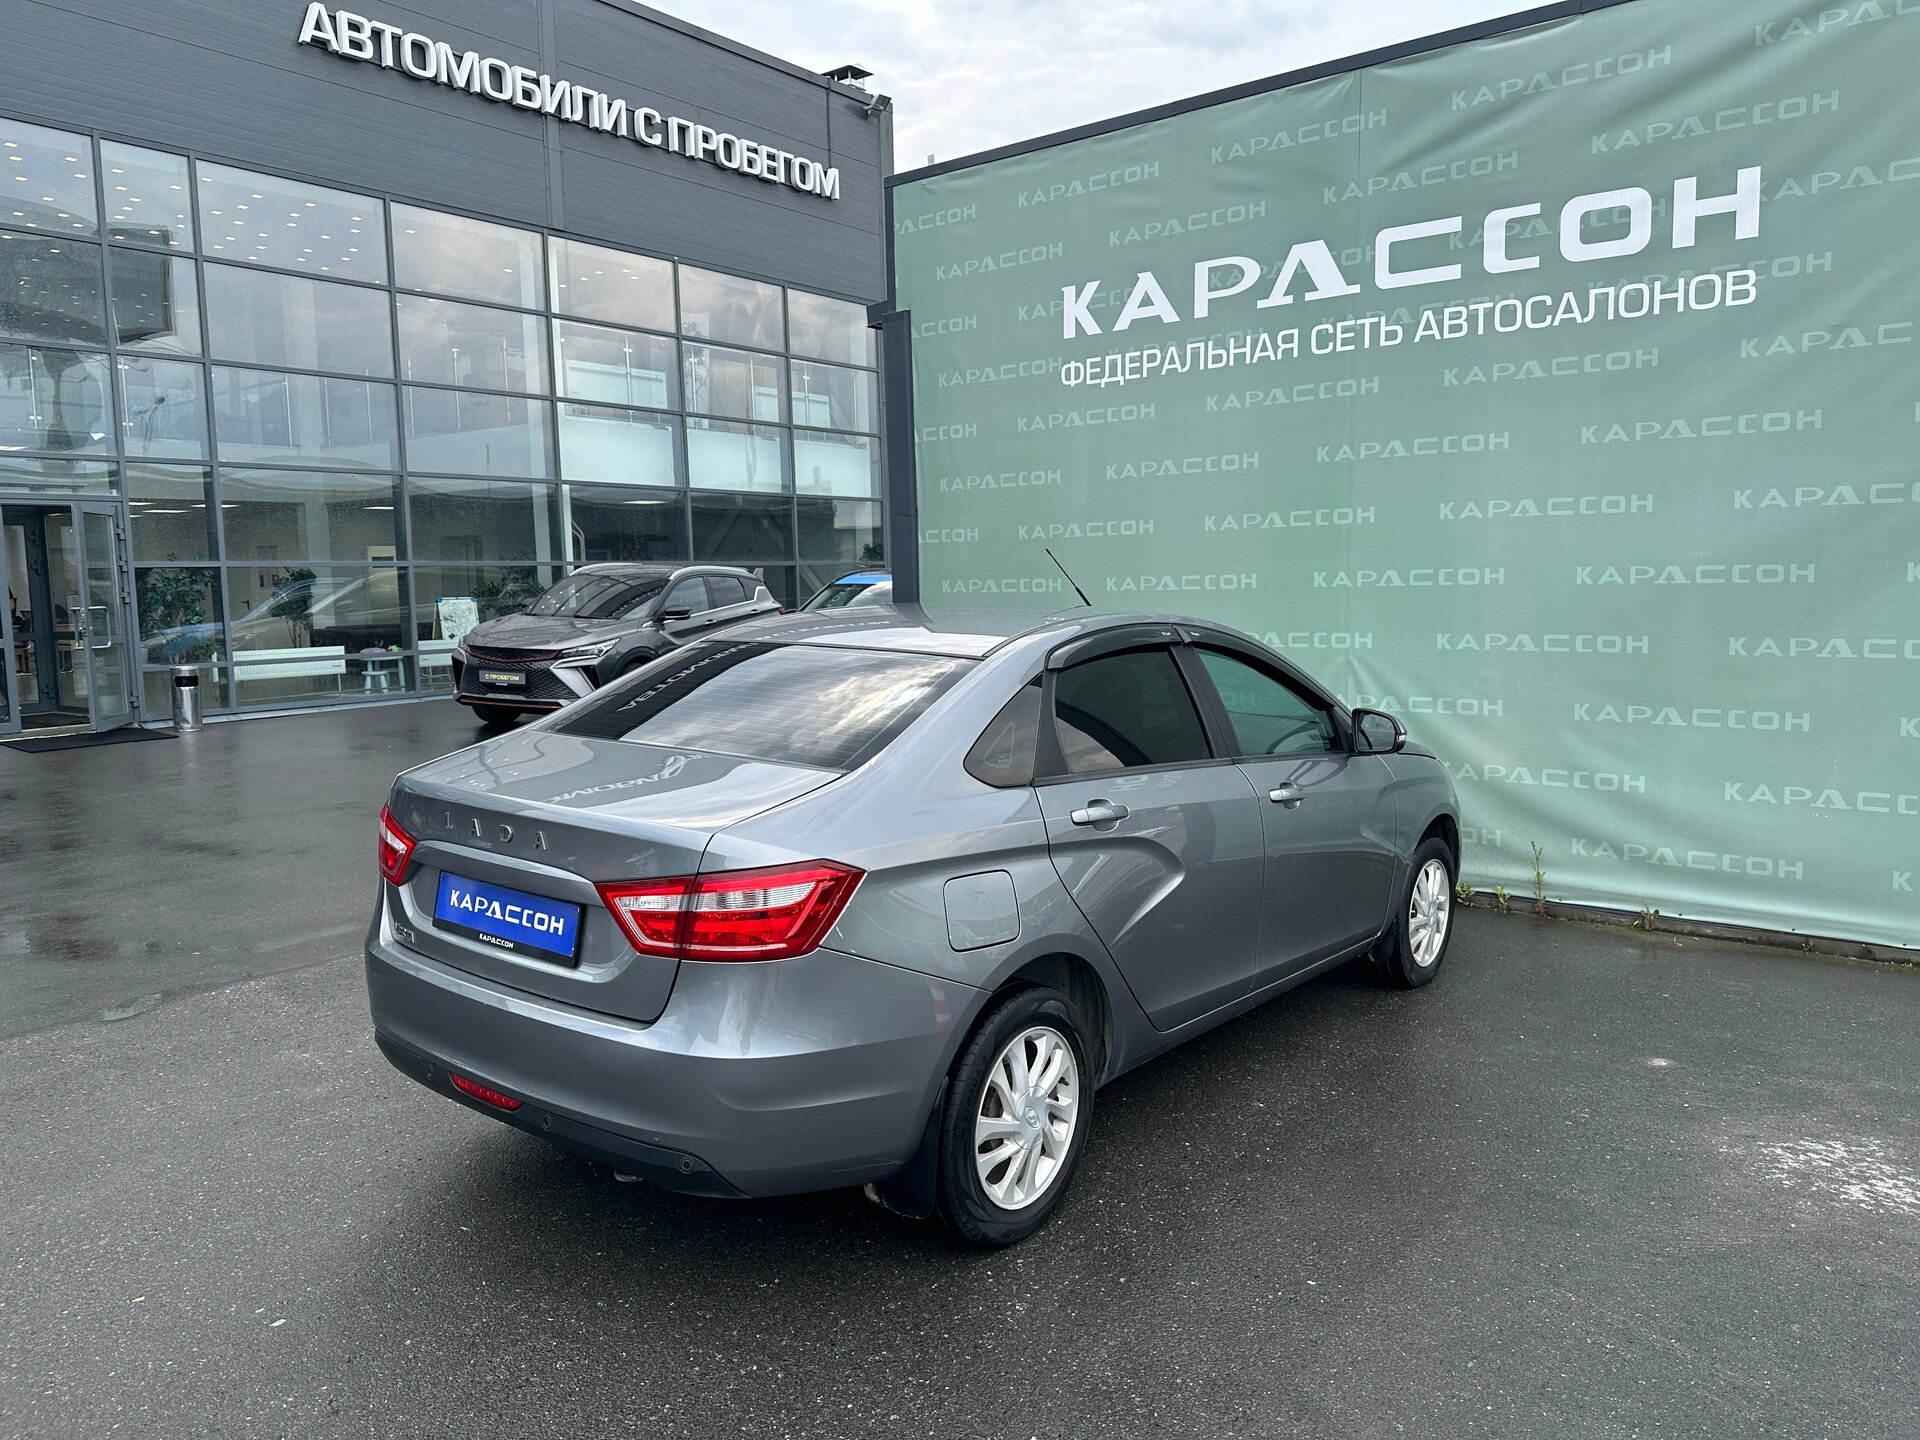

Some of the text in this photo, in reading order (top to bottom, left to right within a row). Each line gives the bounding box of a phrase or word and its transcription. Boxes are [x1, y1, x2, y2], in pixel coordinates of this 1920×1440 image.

[1451, 45, 1672, 111] КАРАССОН
[298, 1, 840, 200] АВТОМОБИЛИ С ПРОБЕГОМ
[1211, 108, 1388, 165] КАРАССОН
[1591, 89, 1840, 155] КАРАССОН
[1018, 160, 1160, 209] КАРАССОН
[1323, 150, 1519, 205] КАРАССОН
[1109, 201, 1266, 248] КАРАССОН
[936, 242, 1063, 281] КАРАССОН
[1061, 166, 1761, 340] КАРАССОН
[1060, 269, 1758, 388] ФЕДЕРАЛЬНАЯ СЕТЬ АВТОСАЛОНОВ
[1740, 322, 1913, 359] КАРАС
[939, 357, 1063, 388] КАРАССОН
[1444, 348, 1660, 387] КАРАССОН
[1206, 377, 1380, 412] КАРАССОН
[1017, 402, 1156, 433] КАРАССОН
[1580, 409, 1823, 445] КАРАССОН
[1316, 431, 1510, 464] КАРАССОН
[940, 469, 1062, 493] КАРАССОН
[1106, 452, 1260, 480] КАРАССОН
[1204, 506, 1376, 533] КАРАССОН
[1438, 494, 1654, 520] КАРАССОН
[1018, 519, 1155, 541] КАРАССОН
[942, 578, 1063, 594] КАРАССОН
[1106, 573, 1258, 592] КАРАССОН
[1313, 567, 1506, 588] КАРАССОН
[1576, 563, 1816, 585] КАРАССОН
[1436, 632, 1650, 655] КАРАССОН
[1573, 702, 1811, 732] КАРАССОН
[1445, 761, 1647, 794] АРАССОН
[445, 811, 548, 851] LADA
[1571, 837, 1804, 880] КАРАССОН
[450, 889, 565, 936] КАРАССОН
[479, 933, 514, 950] КАРАССОН
